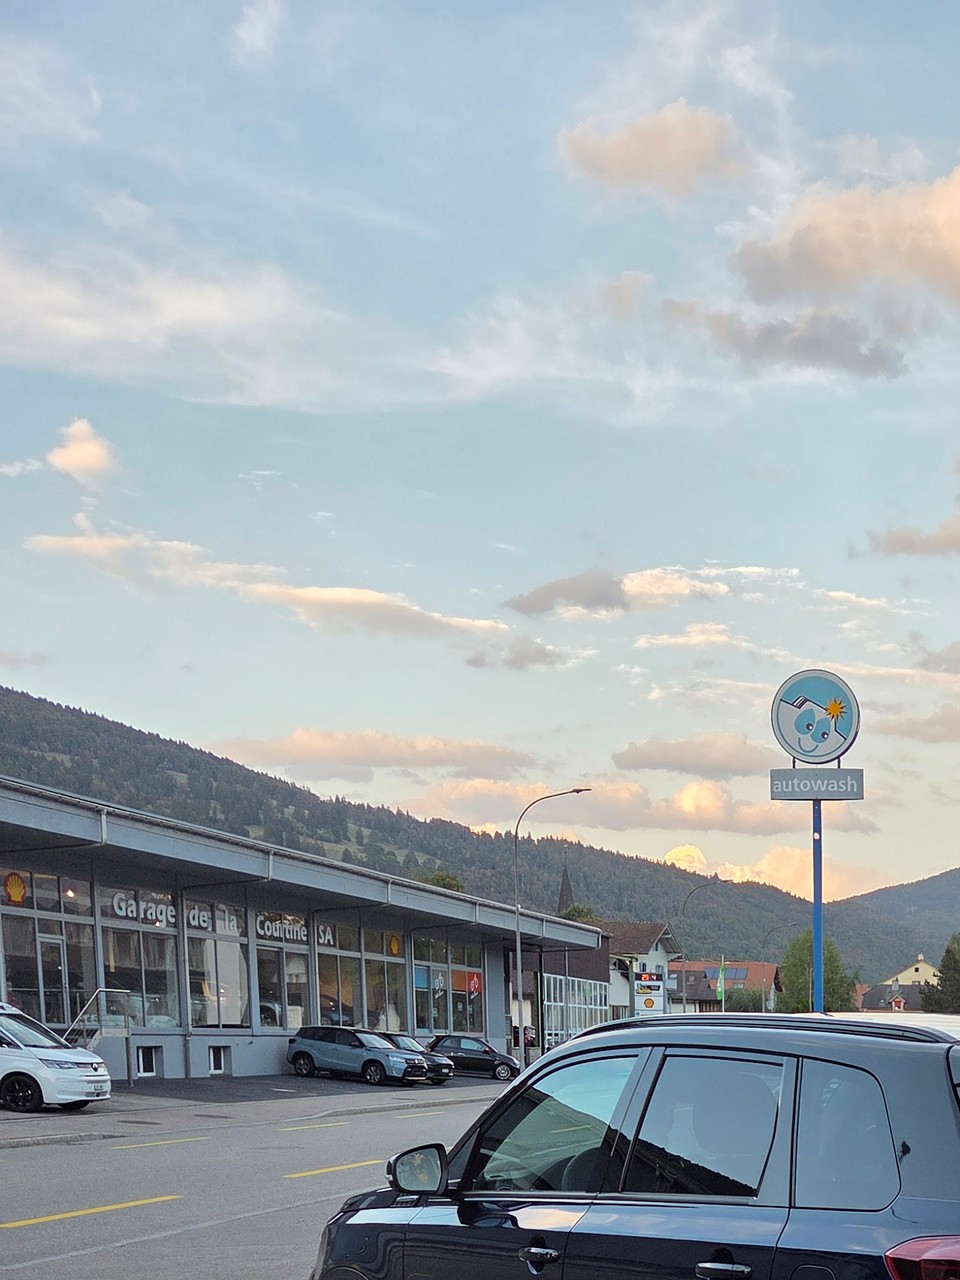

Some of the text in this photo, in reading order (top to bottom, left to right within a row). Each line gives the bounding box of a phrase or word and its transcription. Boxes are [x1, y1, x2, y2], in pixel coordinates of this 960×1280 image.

[773, 775, 857, 792] autowash
[112, 892, 334, 945] Garage de la Courtine SA
